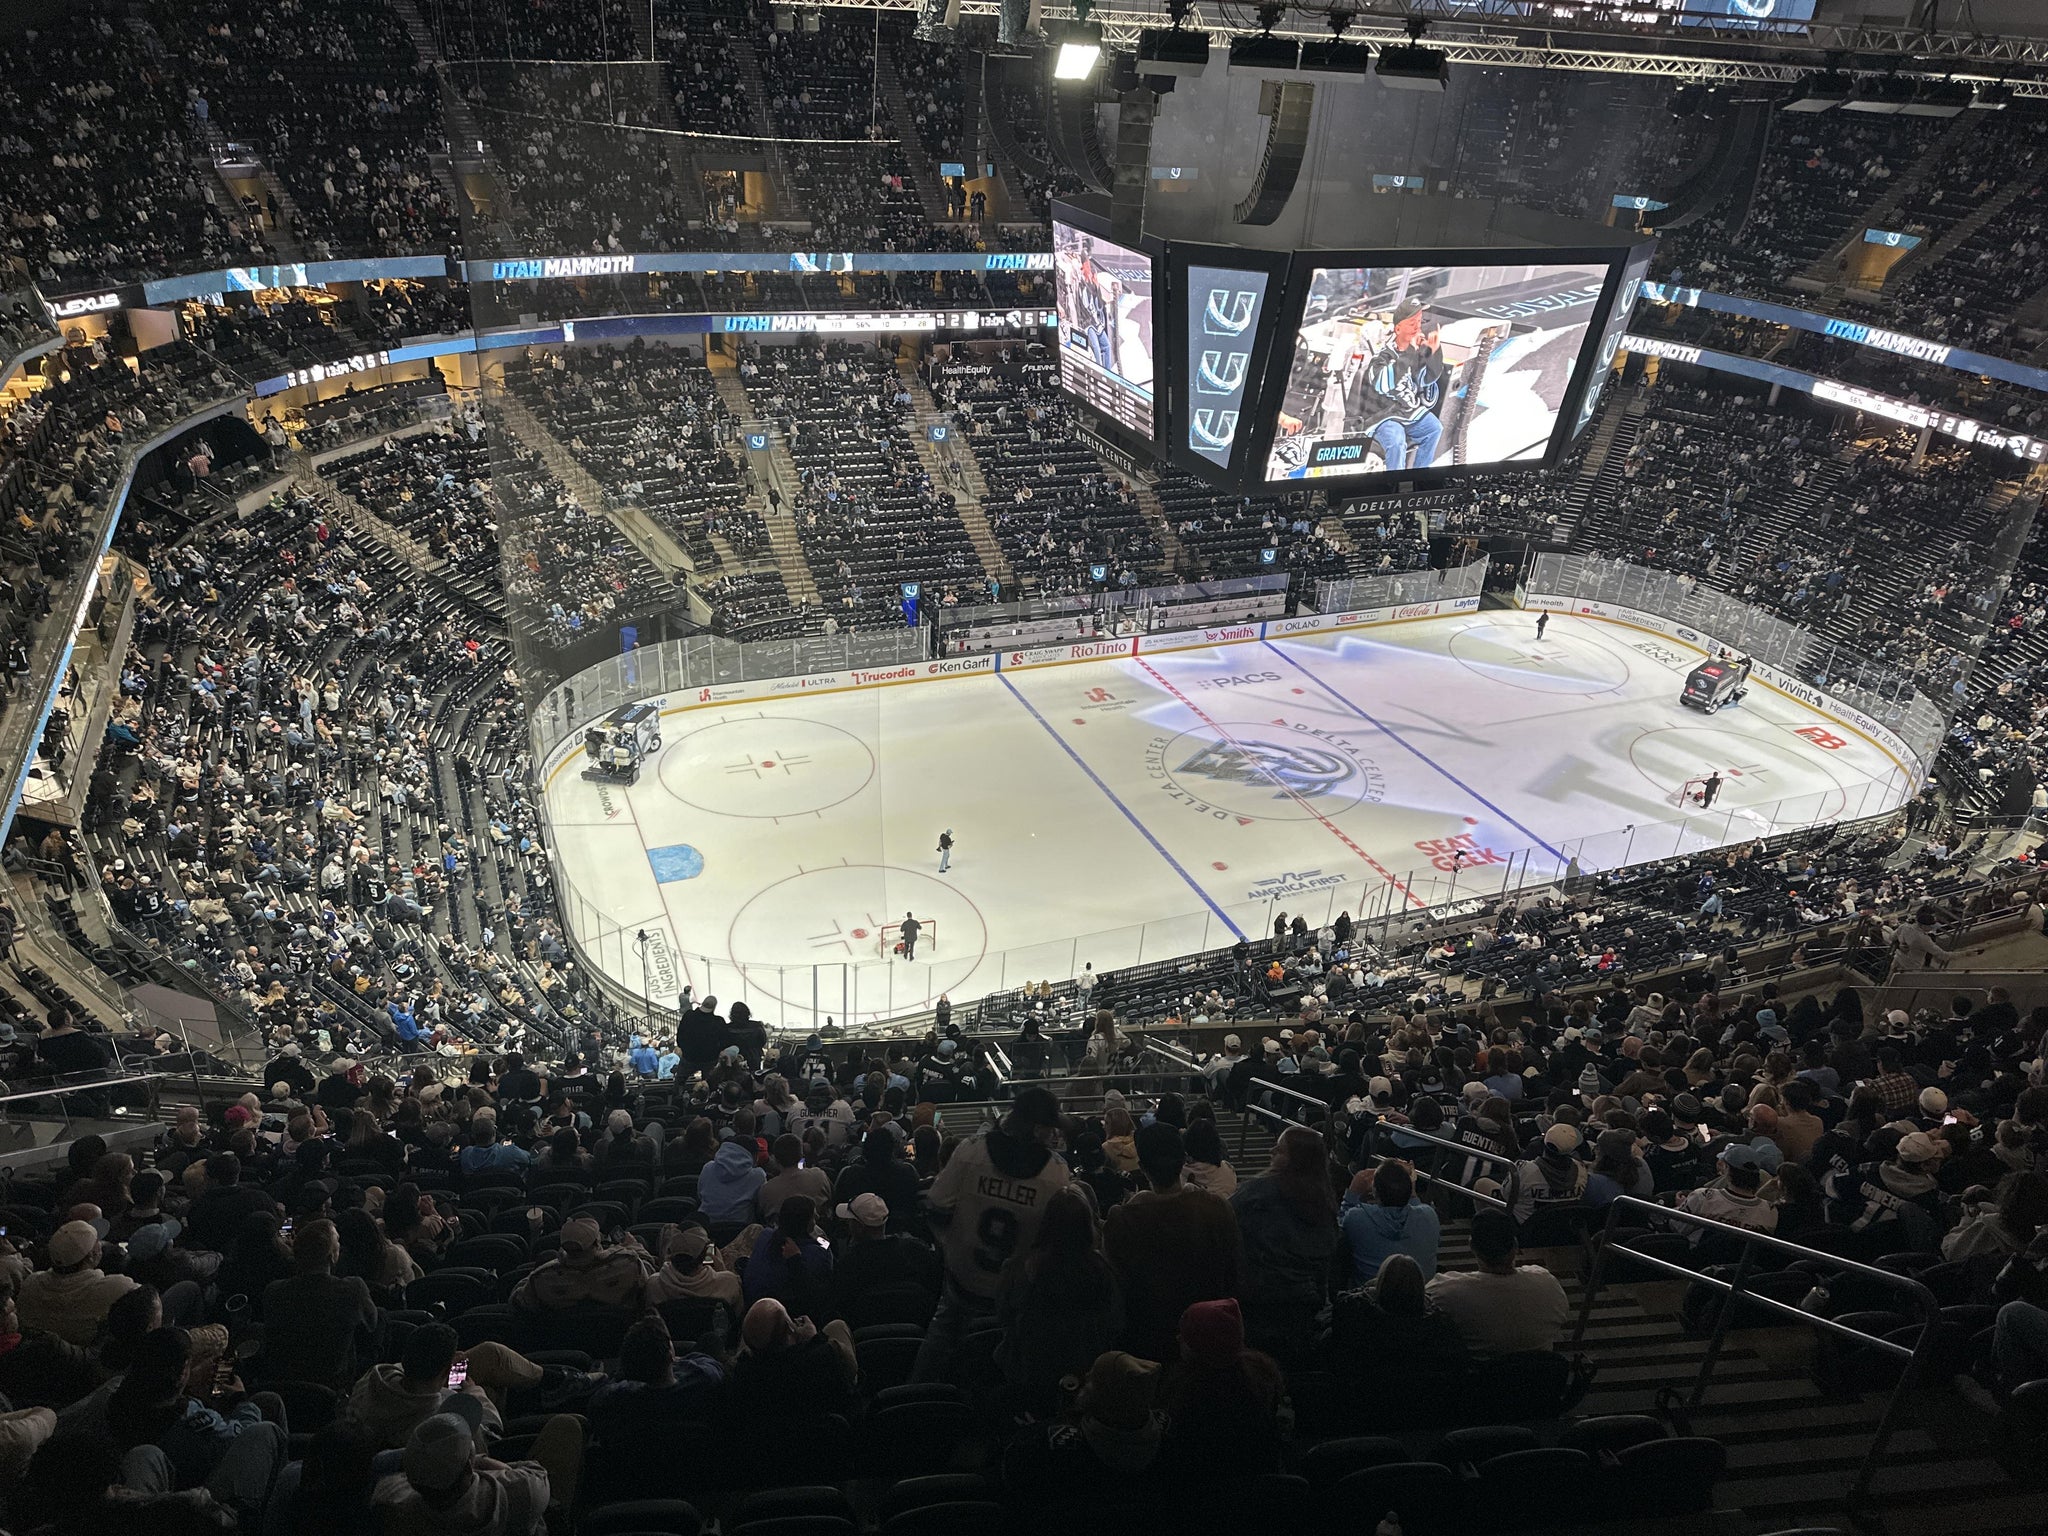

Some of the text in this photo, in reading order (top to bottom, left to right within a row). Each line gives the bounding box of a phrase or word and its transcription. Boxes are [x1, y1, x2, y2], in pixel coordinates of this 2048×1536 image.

[493, 256, 635, 279] UTAH MAMMOTH
[985, 254, 1026, 269] UTAH
[56, 293, 120, 316] LEXUS
[724, 316, 770, 331] UTAH
[950, 314, 959, 326] 2
[981, 316, 1005, 327] 13:04
[1025, 313, 1033, 325] 5
[1619, 336, 1701, 364] MAMMOTH
[1825, 319, 1950, 363] UTAH MAMMOTH
[942, 365, 992, 375] HealthEquity
[1976, 430, 2006, 449] 13:04
[1082, 433, 1132, 473] DELTA CENTER
[1316, 445, 1362, 462] GRAYSON
[1360, 494, 1455, 513] DELTA CENTER
[1454, 598, 1479, 609] Layton
[1540, 599, 1564, 608] Health
[1285, 620, 1319, 631] OKLAND
[1620, 613, 1662, 630] INGREDIENTS
[1219, 627, 1255, 640] Smith's
[1633, 643, 1670, 663] BANK
[1644, 641, 1686, 662] ZIONS
[939, 657, 990, 673] Ken Garff
[808, 677, 836, 686] ULTRA
[861, 668, 916, 682] Trucordia
[1212, 672, 1282, 688] PACS
[1829, 702, 1882, 738] HealthEquity
[1882, 733, 1903, 755] ZIONS
[1294, 723, 1386, 803] DELTA CENTER
[1146, 736, 1229, 820] DELTA CENTER
[1414, 833, 1480, 857] SEAT
[1431, 847, 1507, 872] GEEK
[1248, 874, 1348, 899] AMERICA FIRST
[648, 932, 678, 993] INGREDIENTS
[648, 975, 662, 994] JUST
[977, 1176, 1037, 1207] KELLER
[973, 1207, 1018, 1275] 9
